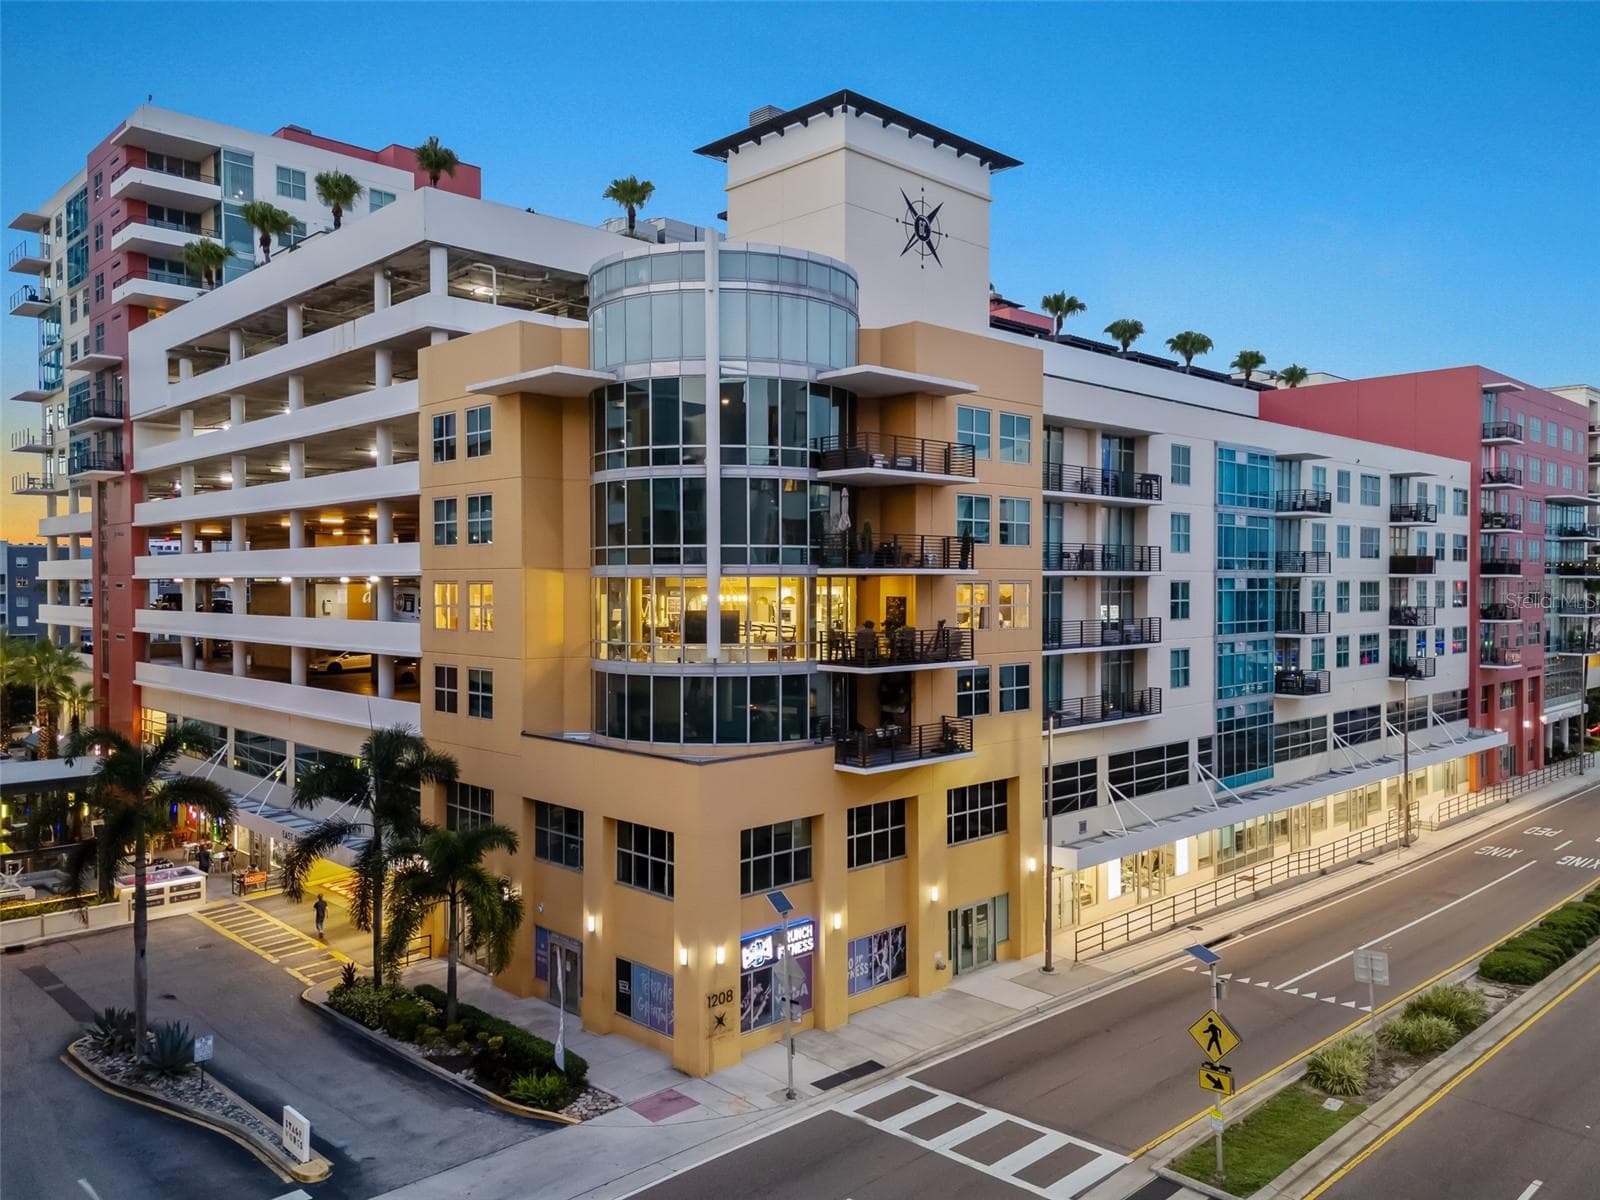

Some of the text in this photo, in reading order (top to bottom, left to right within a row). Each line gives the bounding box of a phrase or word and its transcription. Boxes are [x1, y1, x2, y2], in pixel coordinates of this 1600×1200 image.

[1523, 826, 1564, 837] PED
[1474, 846, 1524, 859] XING
[707, 989, 734, 1009] 1208
